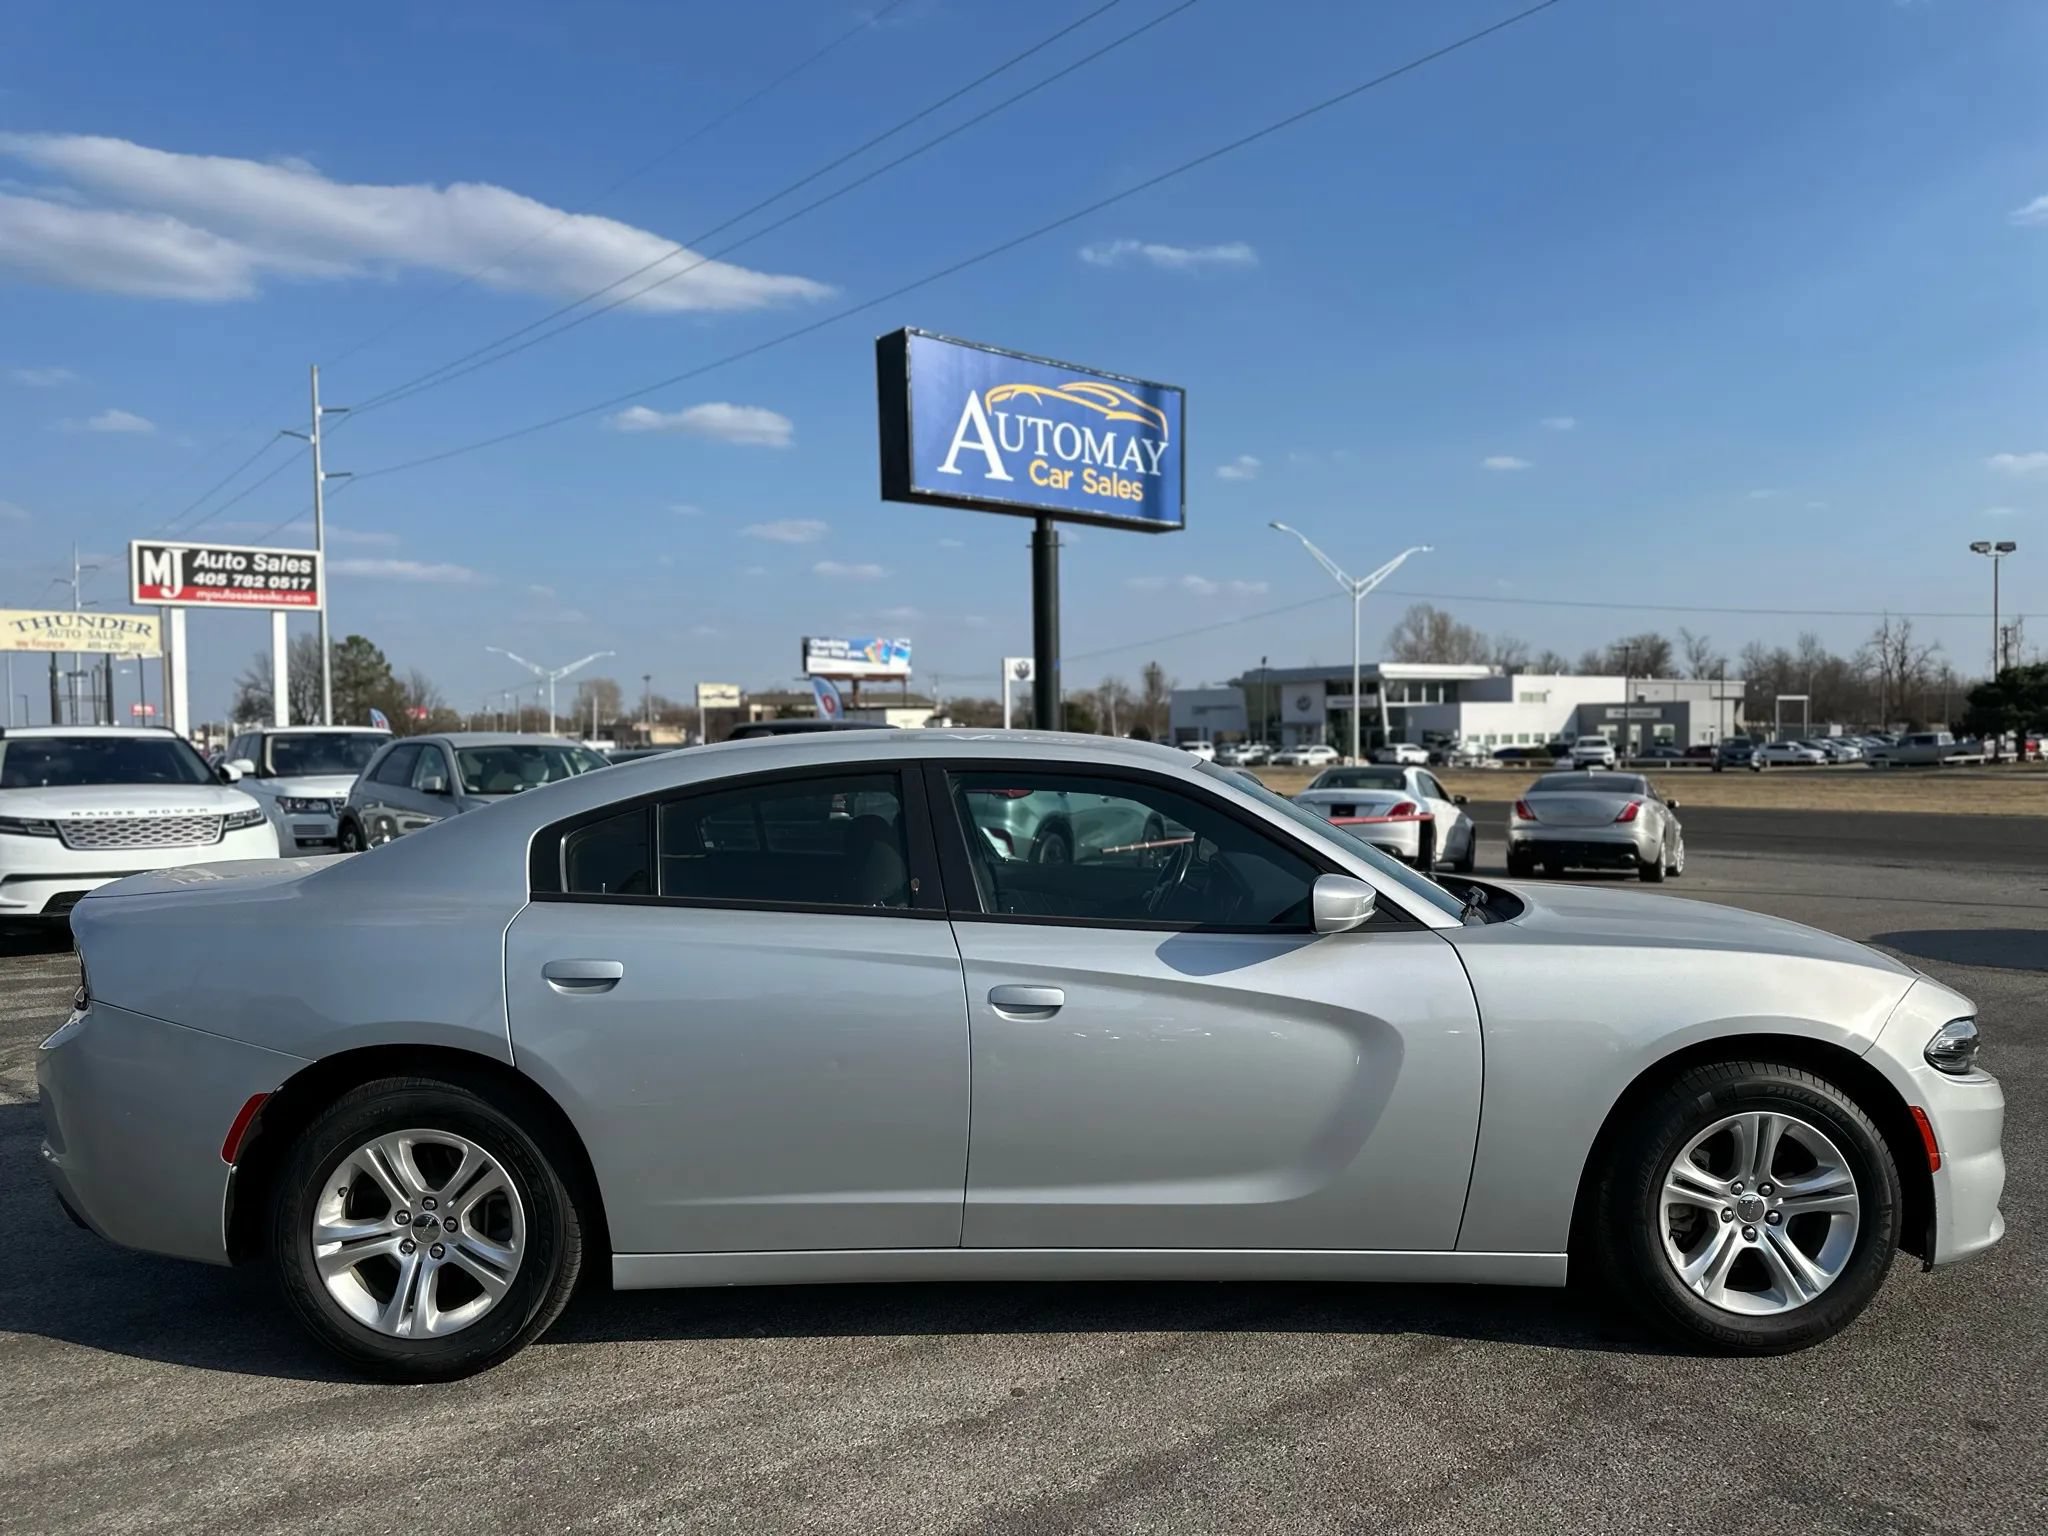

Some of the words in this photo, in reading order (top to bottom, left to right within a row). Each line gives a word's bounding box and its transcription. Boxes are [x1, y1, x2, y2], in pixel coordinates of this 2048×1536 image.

[937, 389, 1169, 482] AUTOMAY
[1028, 459, 1073, 490] Car
[1081, 468, 1144, 502] Sales
[143, 547, 189, 598] MJ
[193, 550, 247, 570] Auto
[252, 554, 312, 574] Sales
[192, 572, 228, 586] 405
[232, 574, 264, 588] 782
[268, 576, 312, 590] 0517
[8, 614, 153, 638] THUNDER
[47, 628, 81, 639] AUTO
[88, 629, 124, 640] SALES
